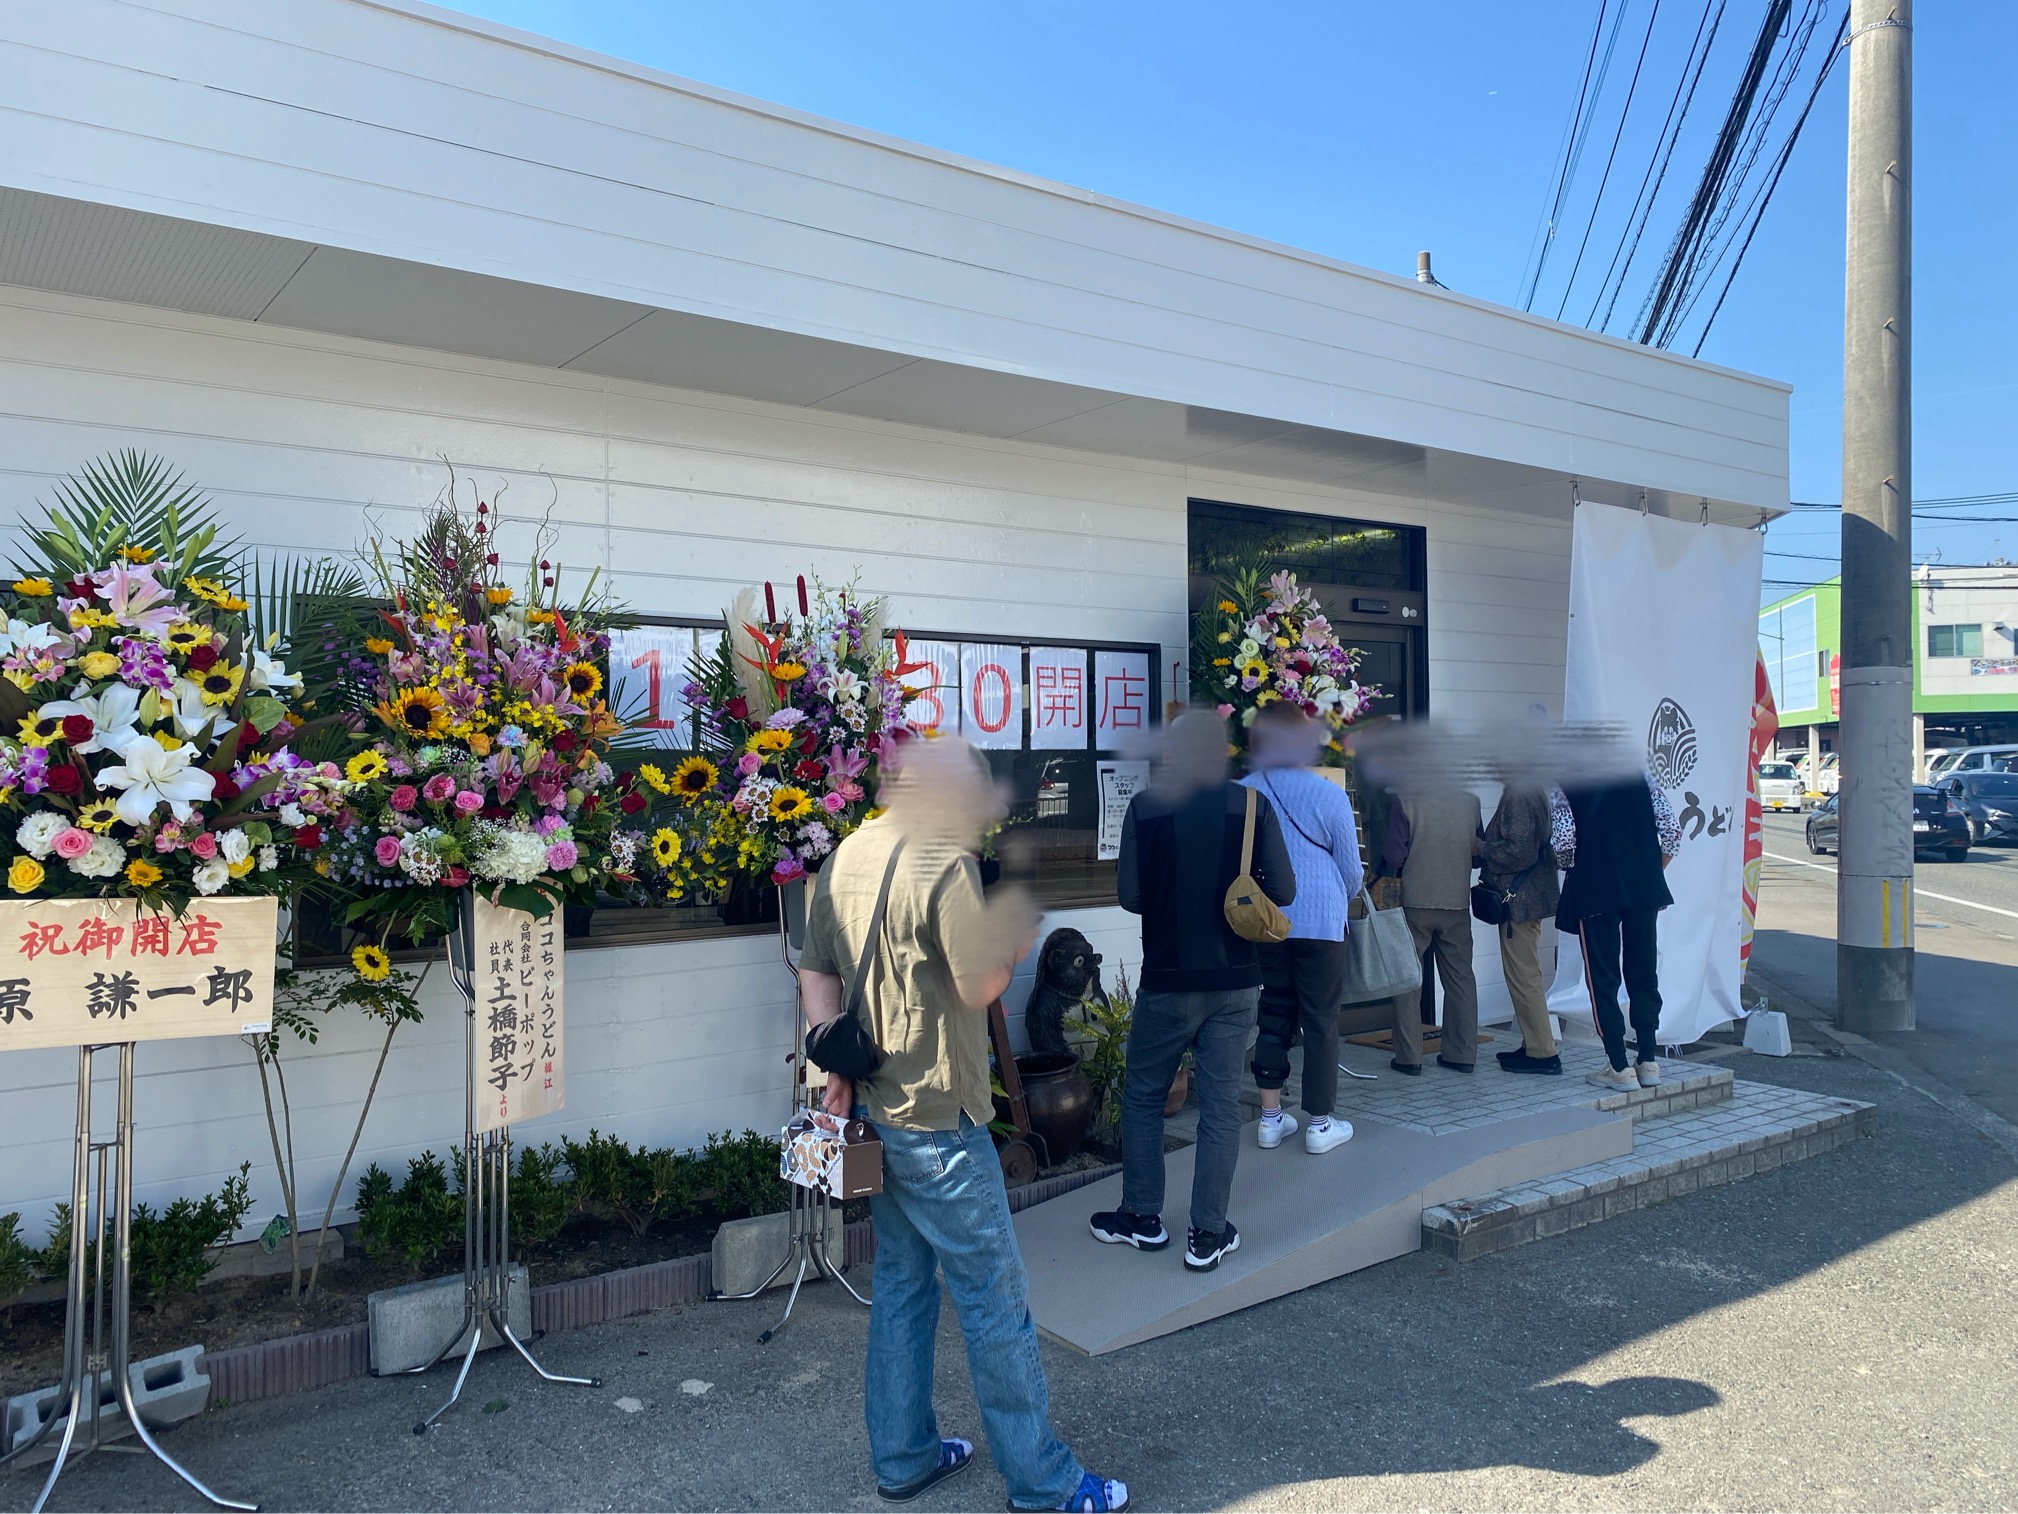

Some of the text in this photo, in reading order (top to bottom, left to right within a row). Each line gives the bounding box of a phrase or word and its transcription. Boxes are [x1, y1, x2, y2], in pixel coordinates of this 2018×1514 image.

[1679, 791, 1734, 841] うど
[18, 914, 223, 961] 祝御開店
[84, 965, 254, 1020] 謙一郎
